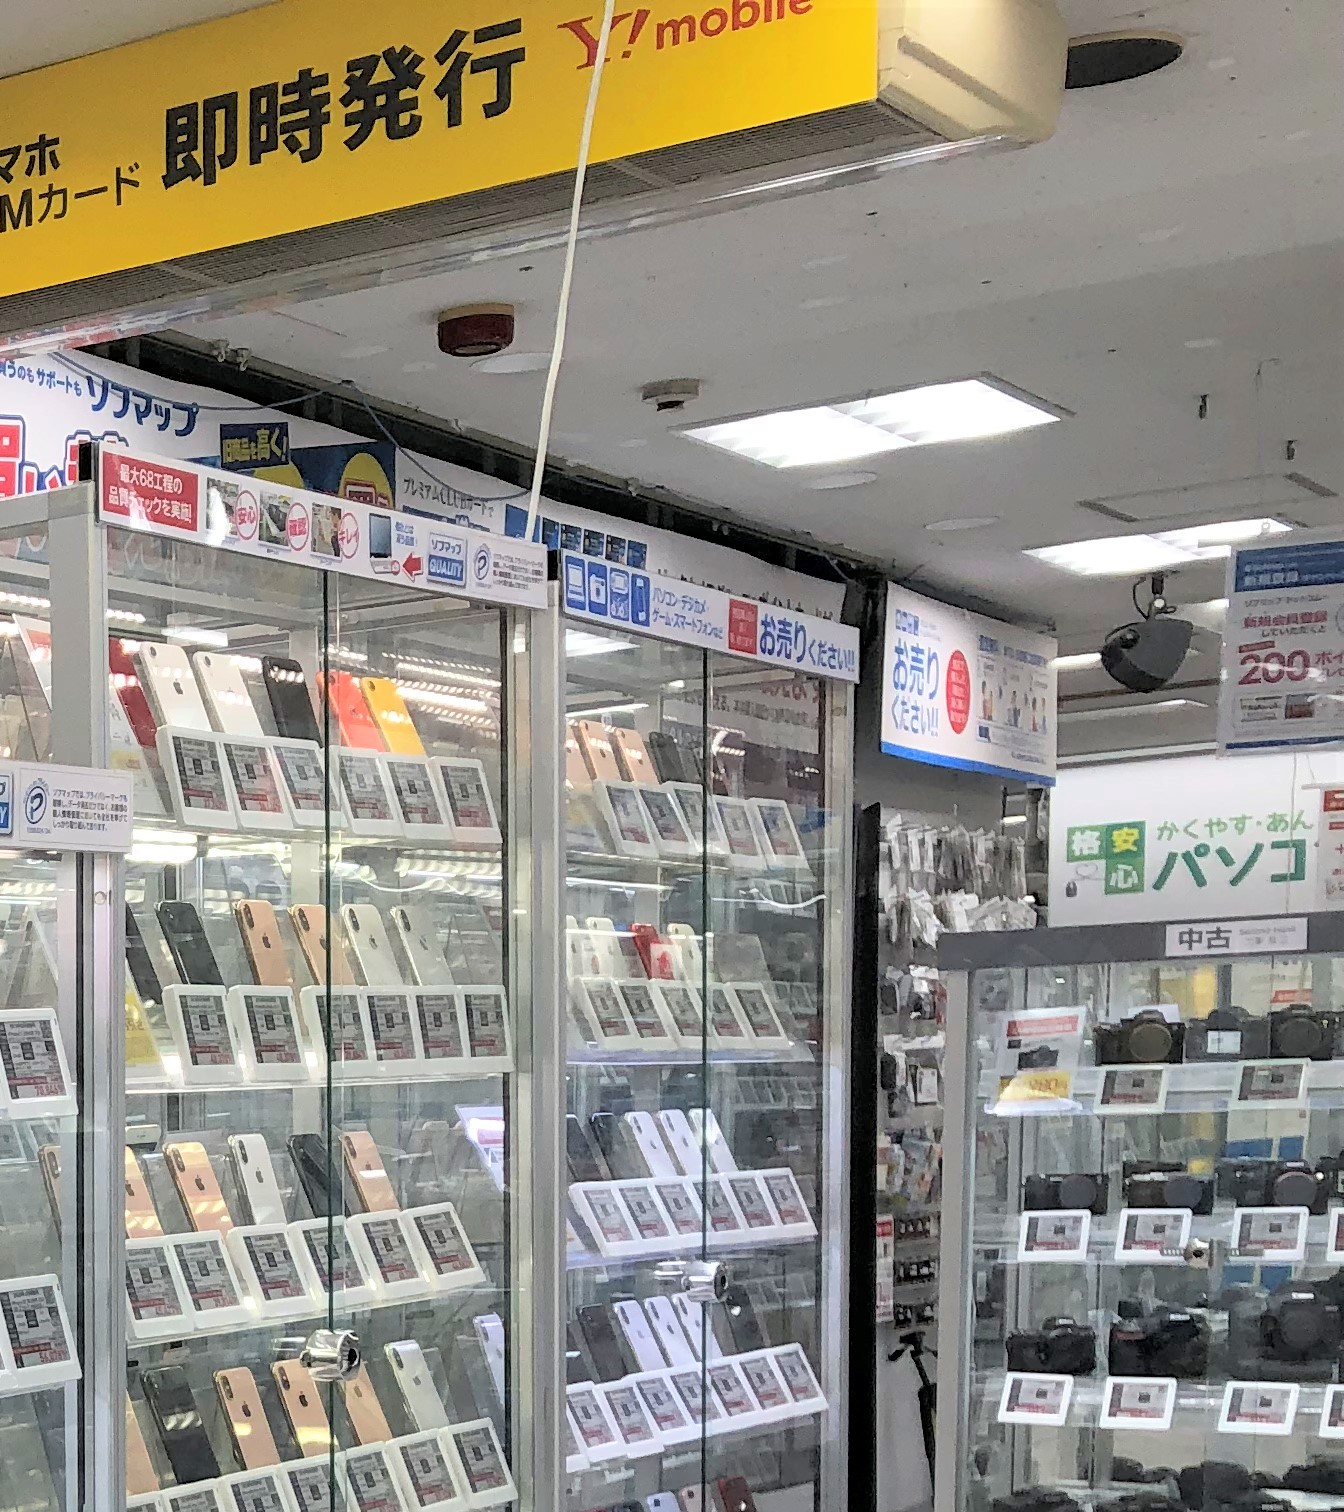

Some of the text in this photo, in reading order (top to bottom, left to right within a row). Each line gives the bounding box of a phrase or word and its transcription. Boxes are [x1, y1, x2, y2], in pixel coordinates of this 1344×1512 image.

[162, 16, 526, 189] 即時発行
[86, 374, 200, 438] ソフマップ
[118, 462, 183, 494] 最大68工程の
[236, 504, 257, 526] 安心
[429, 537, 462, 555] ソフマップ
[427, 559, 464, 583] QUALITY
[892, 637, 940, 700] お売り
[1238, 649, 1311, 686] 200
[1178, 925, 1233, 951] 中古
